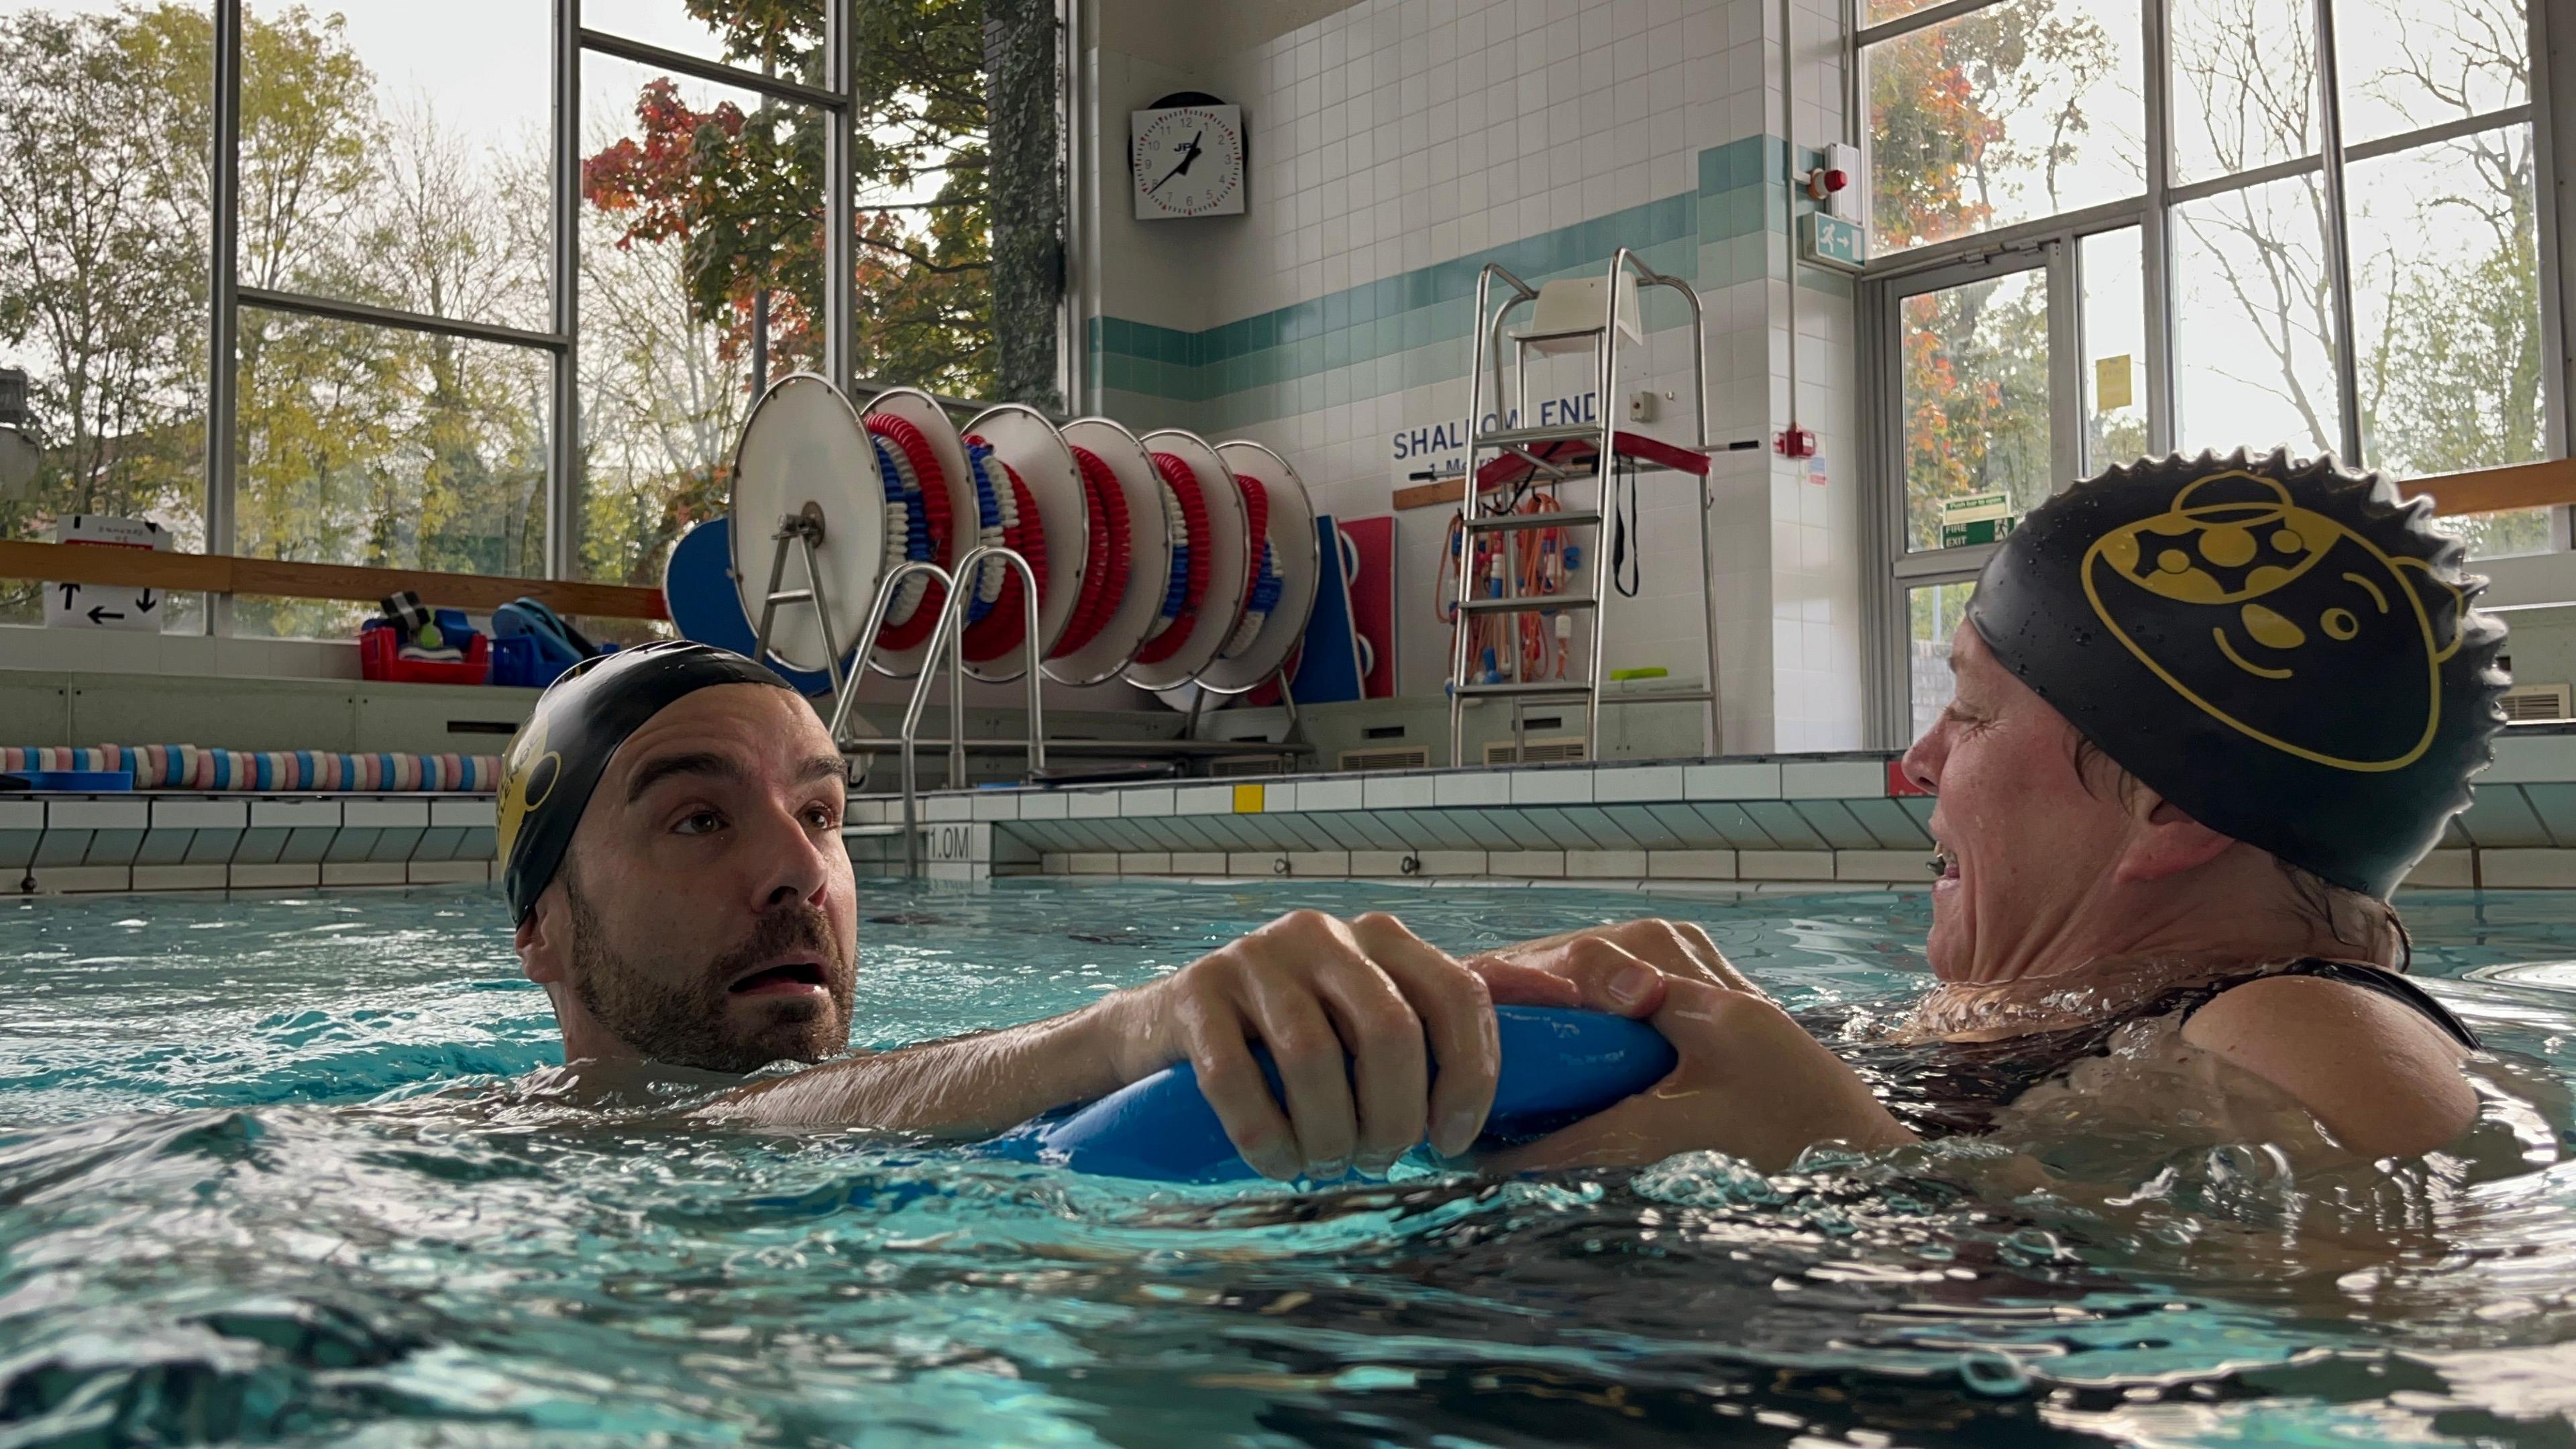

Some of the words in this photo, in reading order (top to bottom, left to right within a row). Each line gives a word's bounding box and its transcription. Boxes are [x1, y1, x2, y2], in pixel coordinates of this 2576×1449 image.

[1180, 117, 1192, 127] 12
[1204, 122, 1209, 131] 1
[1160, 126, 1171, 135] 11
[1148, 140, 1161, 150] 10
[1218, 134, 1225, 145] 2
[1144, 159, 1152, 170] 9
[1224, 154, 1232, 165] 3
[1151, 178, 1159, 189] 8
[1218, 174, 1226, 184] 4
[1167, 192, 1173, 203] 7
[1205, 189, 1213, 199] 5
[1185, 196, 1193, 207] 6
[1949, 501, 1966, 509] Push
[1986, 497, 2002, 506] open
[1945, 523, 1968, 533] FIRE
[1945, 536, 1968, 547] EXIT
[929, 826, 969, 860] 1.0M
